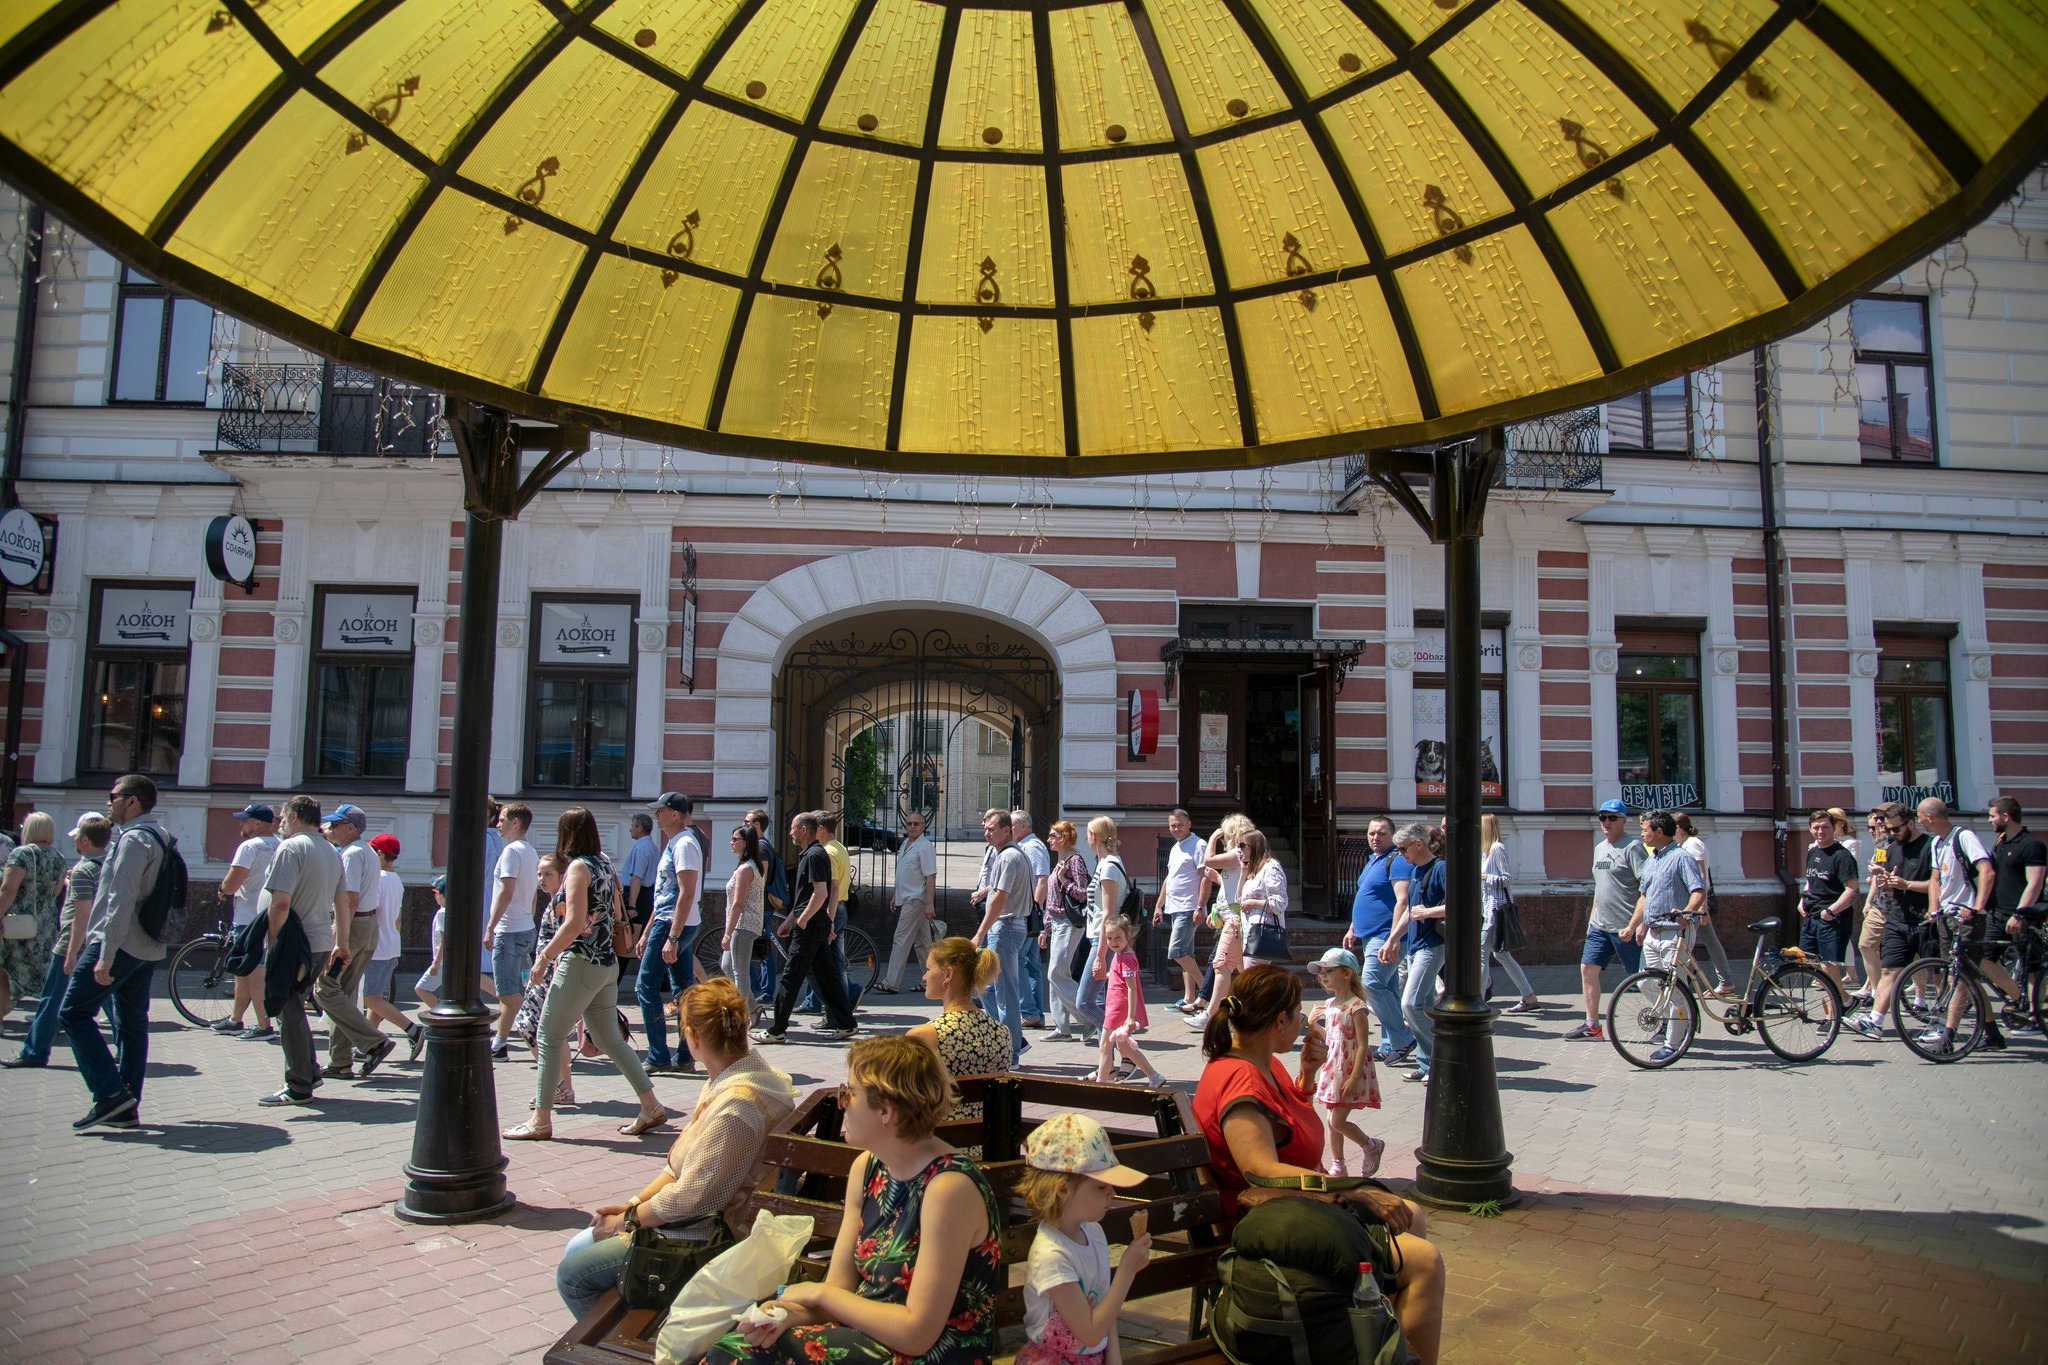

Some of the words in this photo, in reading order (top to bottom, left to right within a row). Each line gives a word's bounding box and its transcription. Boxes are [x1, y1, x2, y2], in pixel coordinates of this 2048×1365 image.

[0, 528, 41, 554] ЛОКОН
[225, 541, 254, 561] СОЛЯРИЙ
[116, 613, 176, 628] ЛОКОН
[338, 618, 398, 632] ЛОКОН
[556, 627, 616, 642] ЛОКОН
[1428, 784, 1446, 794] Brit
[1621, 783, 1698, 810] СЕМЕНА
